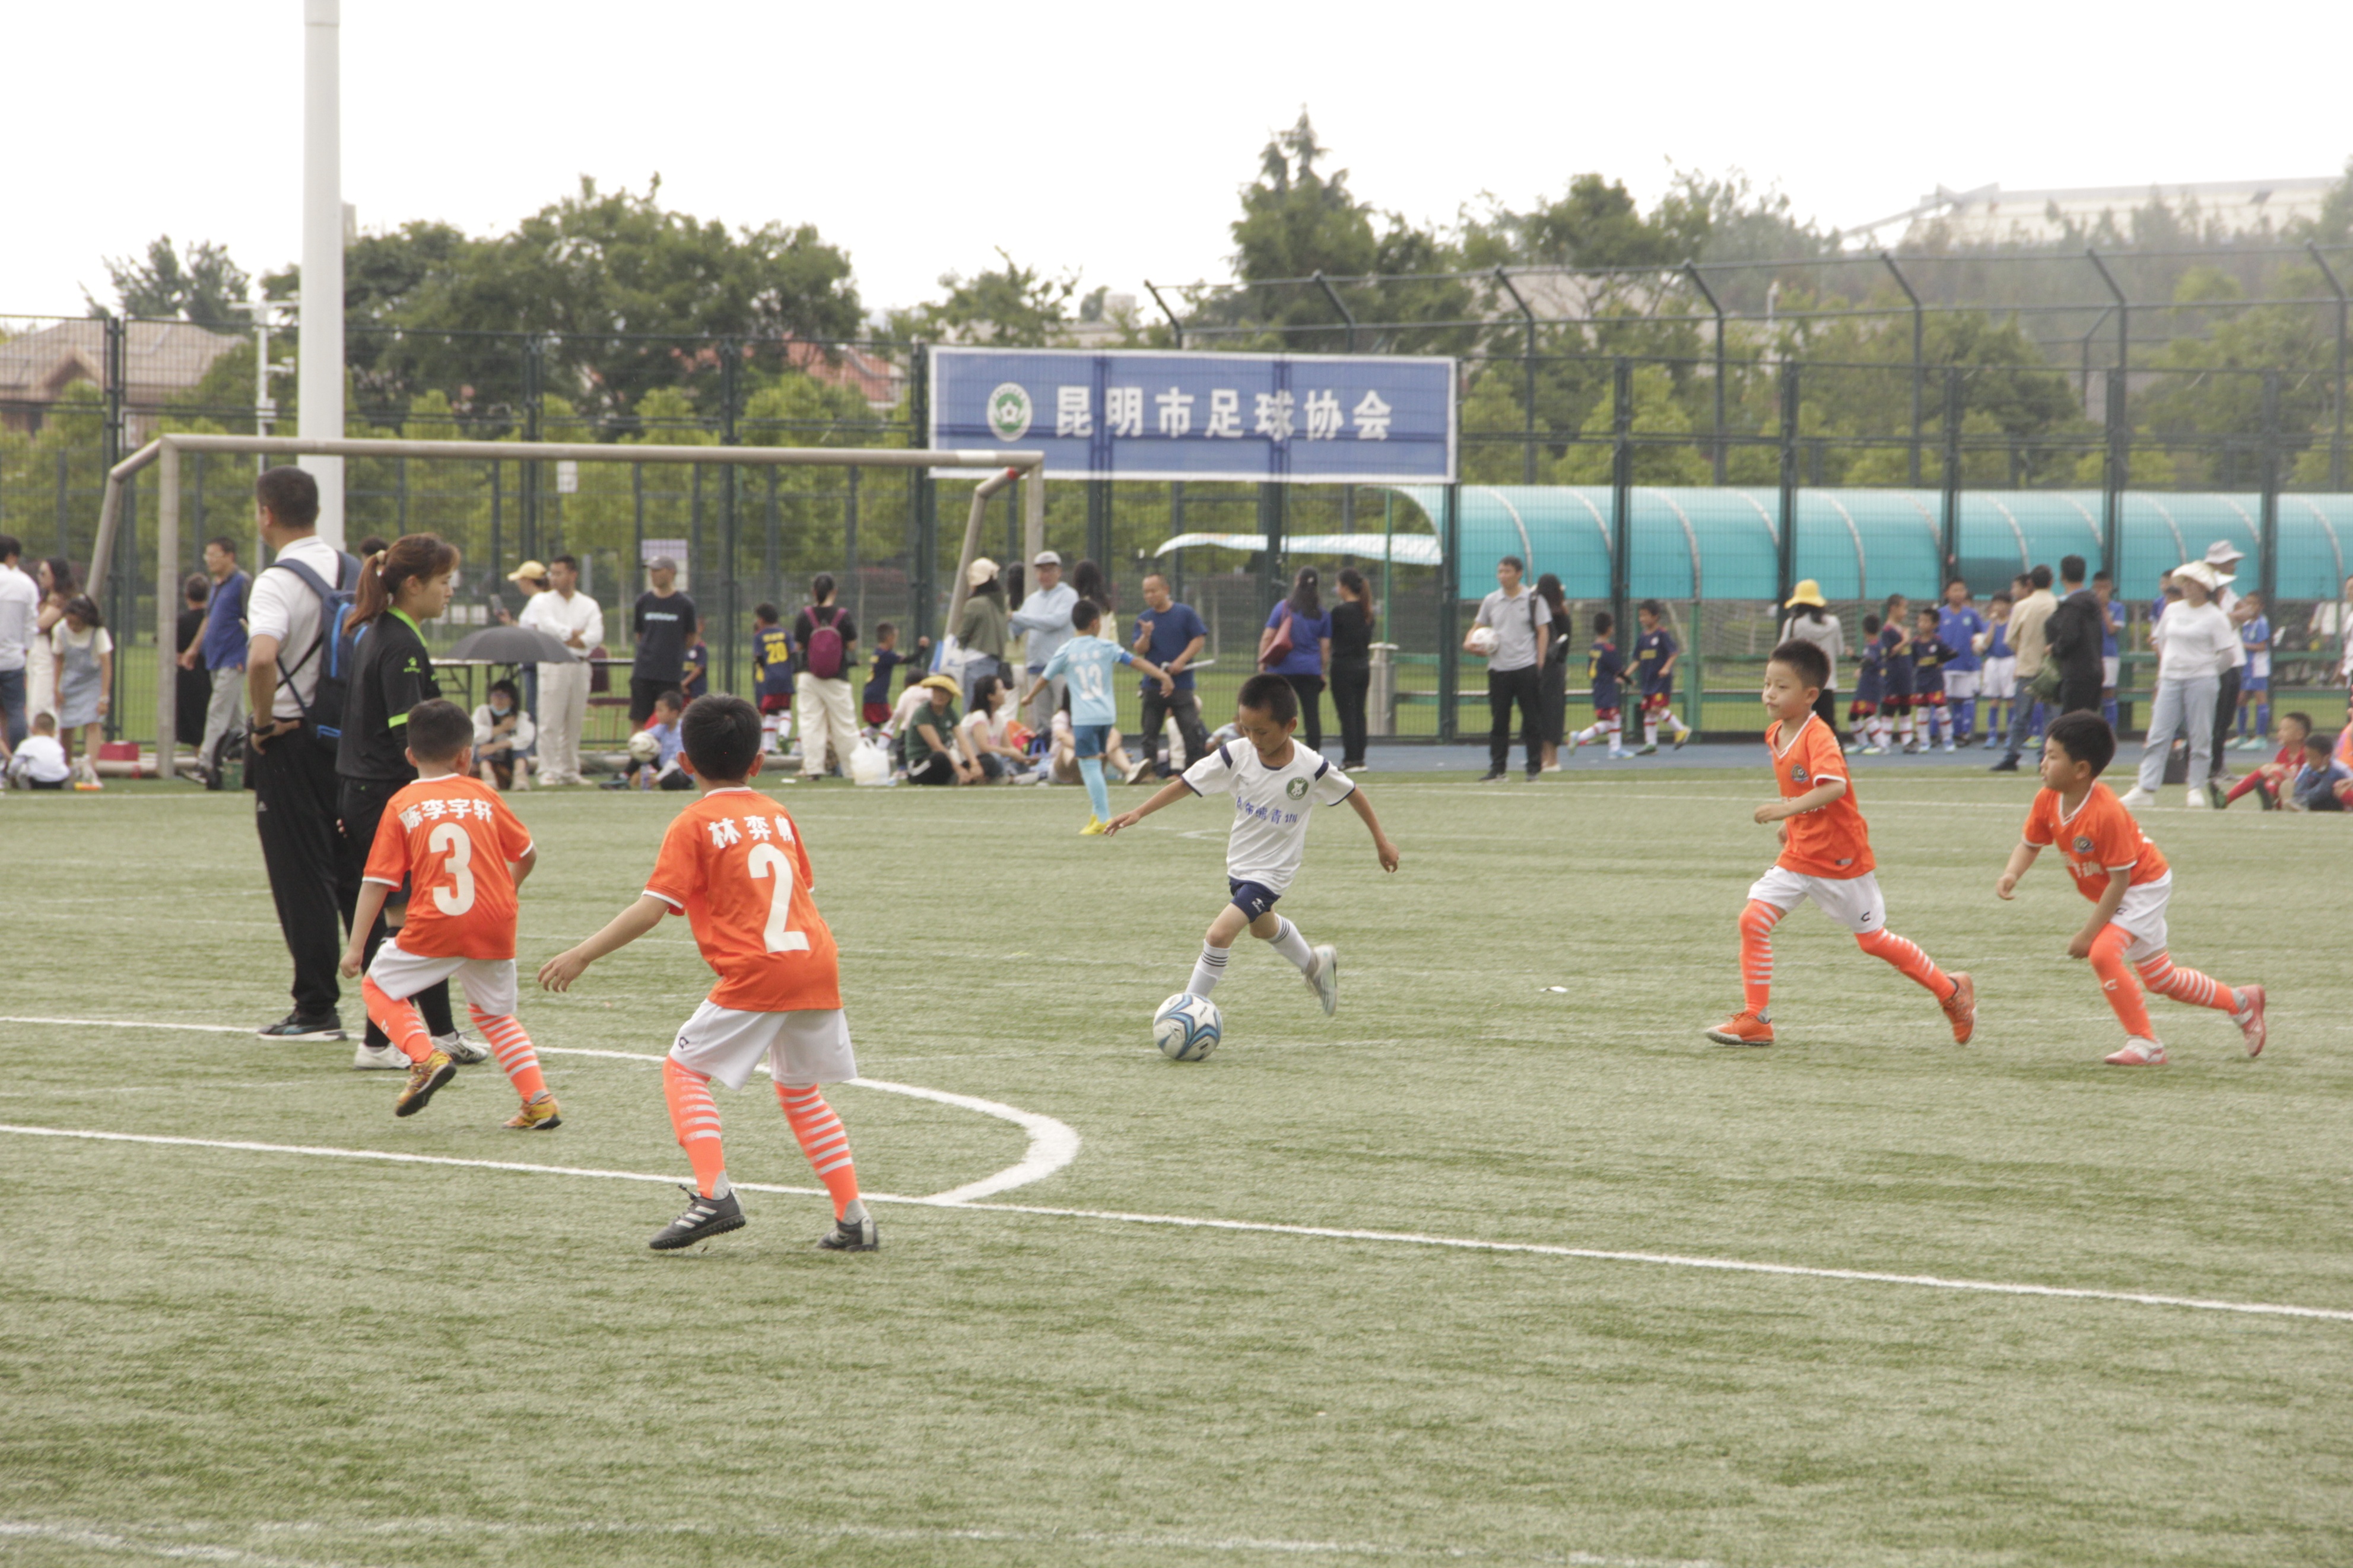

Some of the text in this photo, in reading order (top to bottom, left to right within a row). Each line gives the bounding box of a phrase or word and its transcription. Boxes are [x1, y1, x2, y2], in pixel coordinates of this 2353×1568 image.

[1056, 386, 1392, 441] 昆明市足球协会
[428, 822, 475, 916] 3
[748, 842, 811, 953] 2
